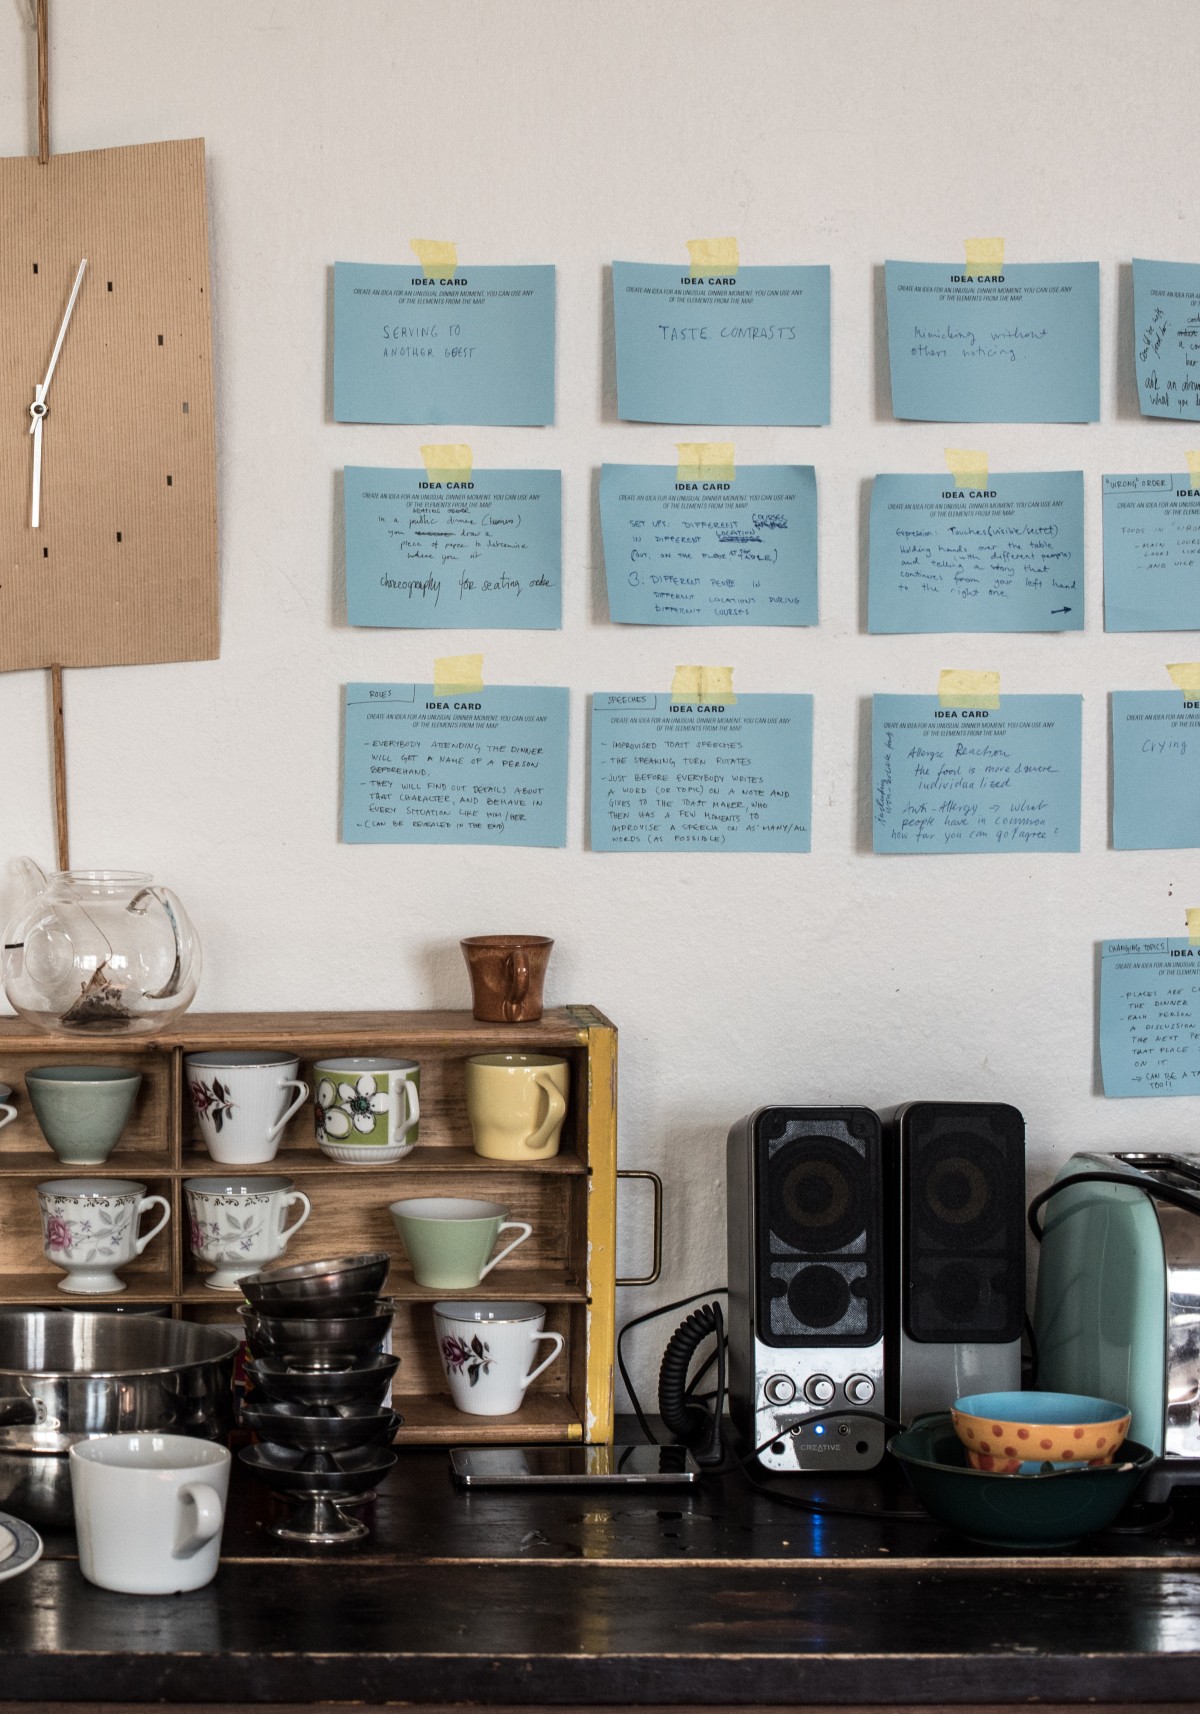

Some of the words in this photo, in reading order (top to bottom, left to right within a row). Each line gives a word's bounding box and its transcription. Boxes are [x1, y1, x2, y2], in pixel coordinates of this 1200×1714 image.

[411, 278, 435, 286] IDEA
[439, 278, 468, 286] CARD
[680, 277, 704, 285] IDEA
[708, 277, 736, 285] CARD
[950, 275, 974, 283] IDEA
[977, 275, 1005, 284] CARD
[383, 325, 438, 339] SERVING
[659, 325, 708, 340] TASTE
[720, 325, 797, 340] CONTRASTS
[383, 347, 434, 357] ANOTHER
[675, 483, 698, 491] IDEA
[702, 483, 730, 491] CARD
[1141, 479, 1167, 488] ORDER
[941, 490, 965, 499] IDEA
[969, 490, 997, 499] CARD
[607, 696, 646, 704] SPEECHES
[425, 702, 449, 710] IDEA
[453, 703, 482, 711] CARD
[669, 705, 693, 713] IDEA
[697, 705, 725, 713] CARD
[1183, 701, 1200, 709] IDE
[934, 710, 958, 718] IDEA
[961, 710, 989, 718] CARD
[372, 740, 421, 749] EVERYBODY
[486, 745, 507, 753] THE
[371, 754, 393, 762] WILL
[439, 756, 464, 764] NAME
[502, 760, 539, 768] PERSON
[683, 758, 706, 766] TURN
[608, 774, 628, 782] JUST
[635, 774, 669, 782] BEFORE
[676, 774, 725, 782] EVERYBODY
[732, 774, 764, 783] WRITES
[622, 786, 647, 794] WORD
[728, 788, 735, 796] A
[639, 799, 648, 807] TO
[656, 799, 673, 807] THE
[608, 811, 629, 819] THEN
